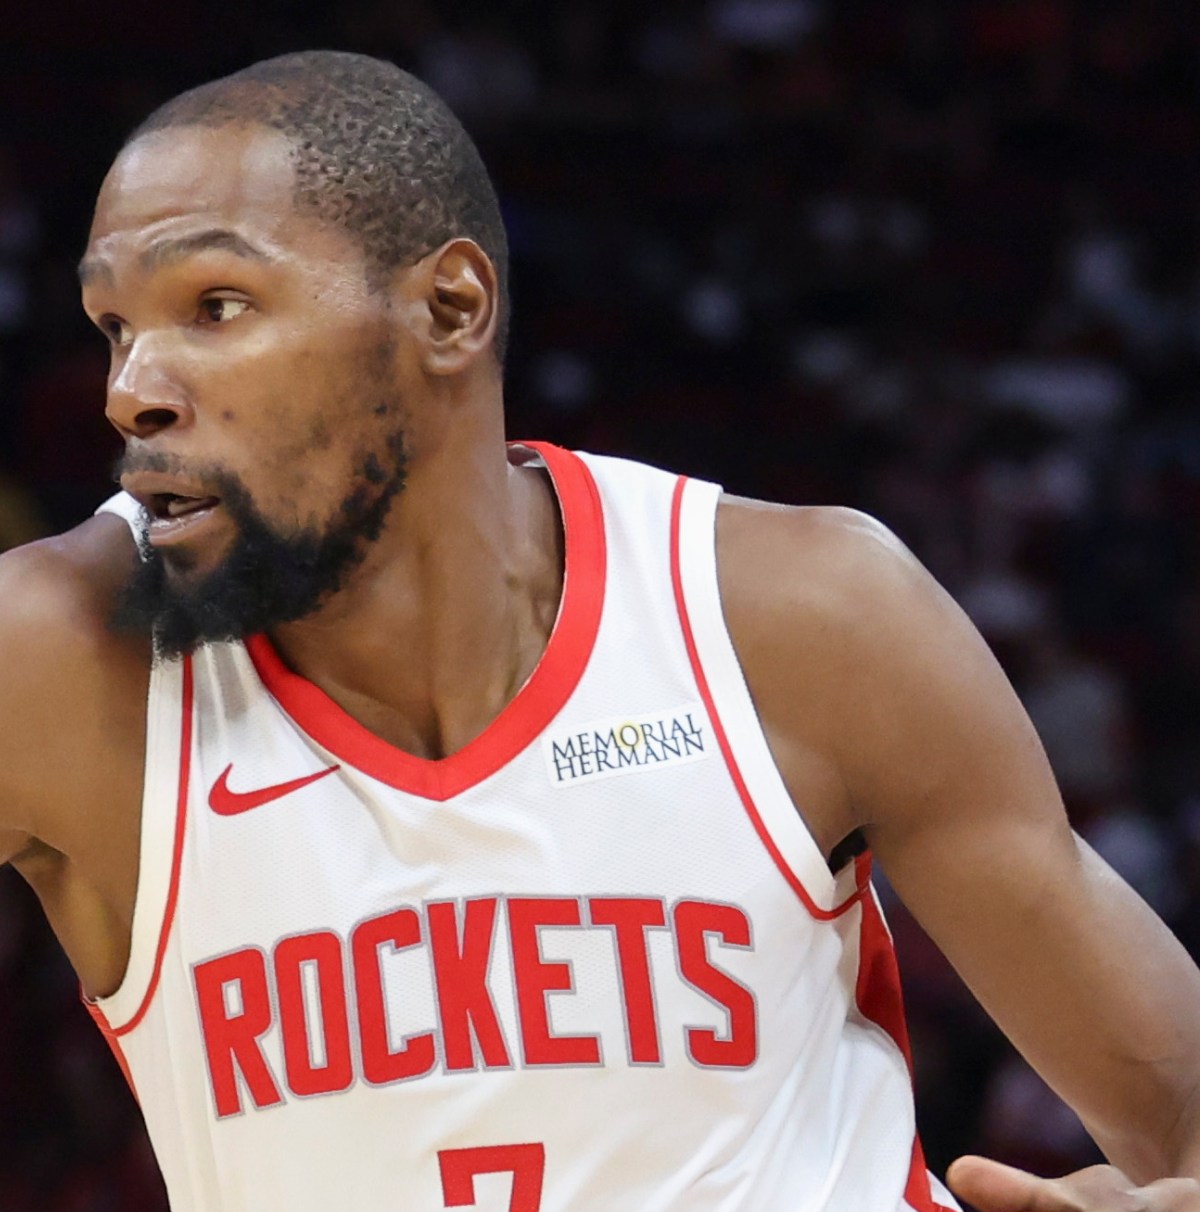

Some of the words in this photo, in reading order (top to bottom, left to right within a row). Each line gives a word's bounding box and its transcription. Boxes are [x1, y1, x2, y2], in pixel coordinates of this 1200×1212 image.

[551, 713, 703, 763] MEMORIAL
[554, 731, 705, 782] HERMANN
[189, 892, 759, 1121] ROCKETS
